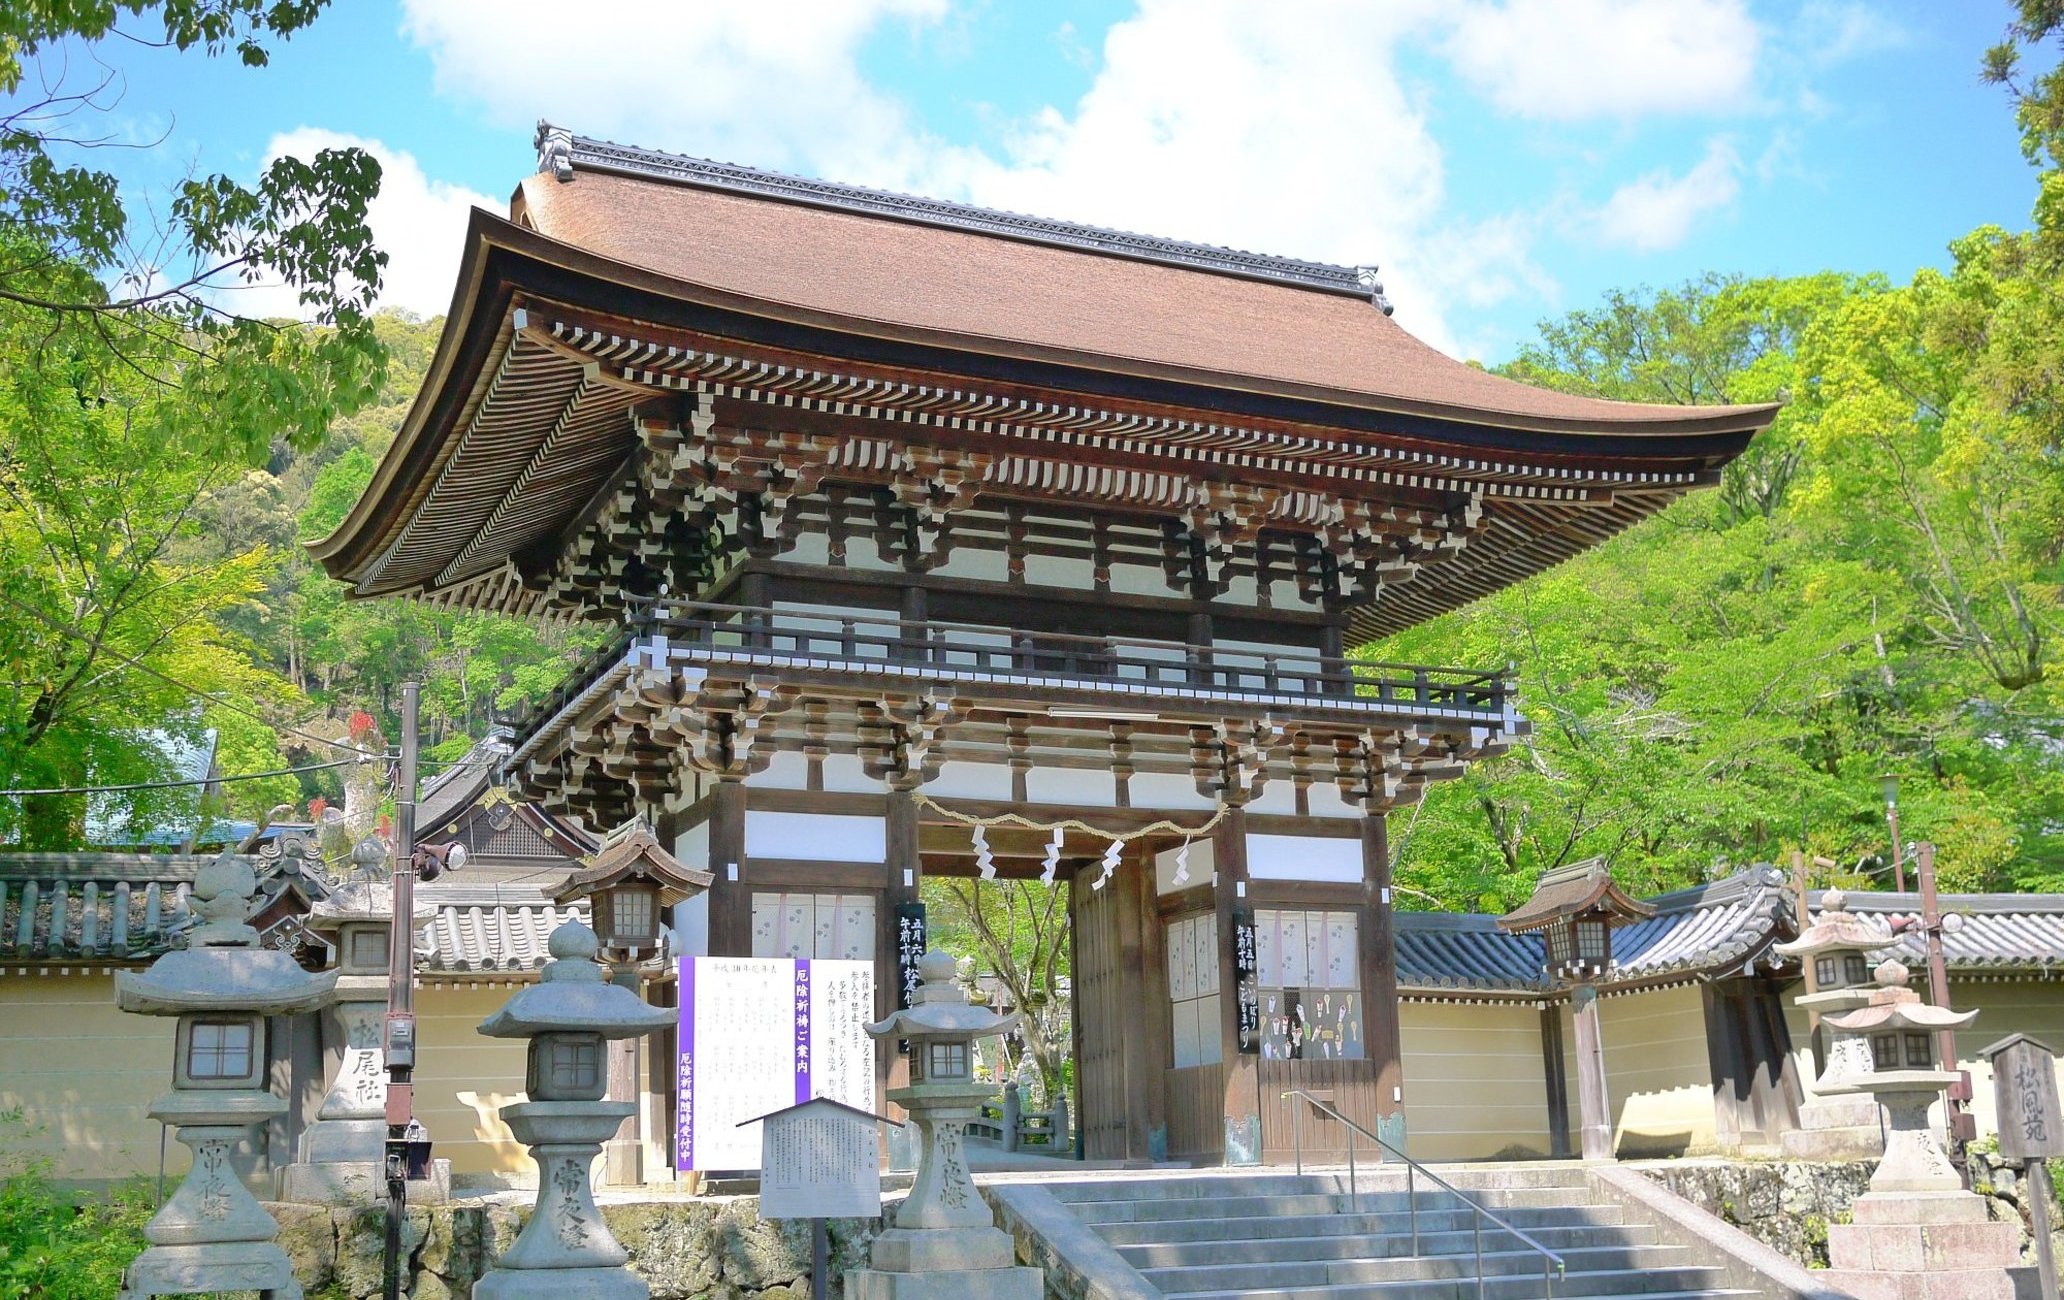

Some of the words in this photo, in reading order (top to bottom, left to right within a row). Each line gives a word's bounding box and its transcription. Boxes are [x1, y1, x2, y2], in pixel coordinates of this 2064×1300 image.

[899, 916, 911, 965] 午前十時
[911, 918, 923, 965] 五月六日
[1237, 924, 1247, 971] 午前十時
[1244, 926, 1255, 970] 五月五日
[796, 969, 809, 1074] 厄除祈祷ご案内
[1239, 980, 1249, 1048] こどもまつり
[1248, 974, 1258, 1030] こいのぼり
[679, 1052, 692, 1162] 厄除祈願随時受付中
[2014, 1063, 2048, 1141] 松風苑
